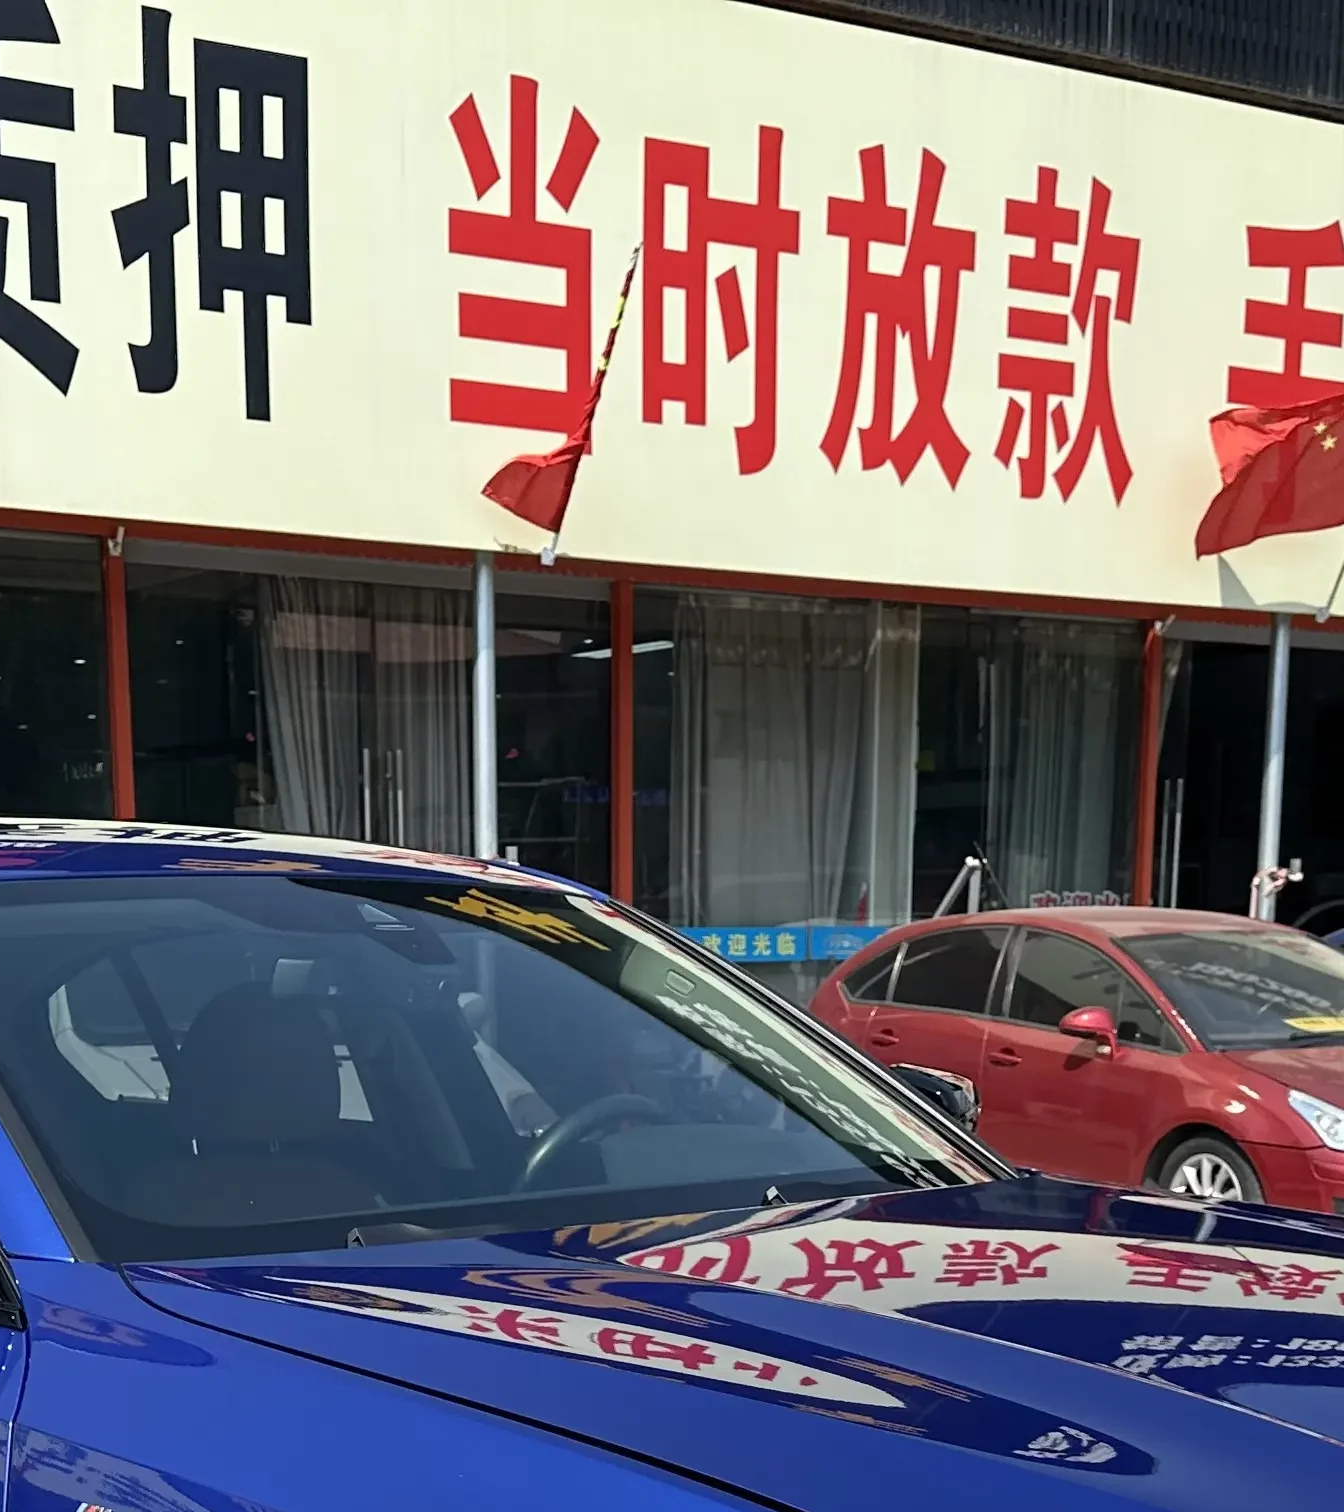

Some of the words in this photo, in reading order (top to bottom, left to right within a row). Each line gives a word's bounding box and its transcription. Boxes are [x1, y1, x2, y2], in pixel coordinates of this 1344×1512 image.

[448, 74, 1141, 506] 当时放款
[701, 933, 797, 957] 欢迎光临
